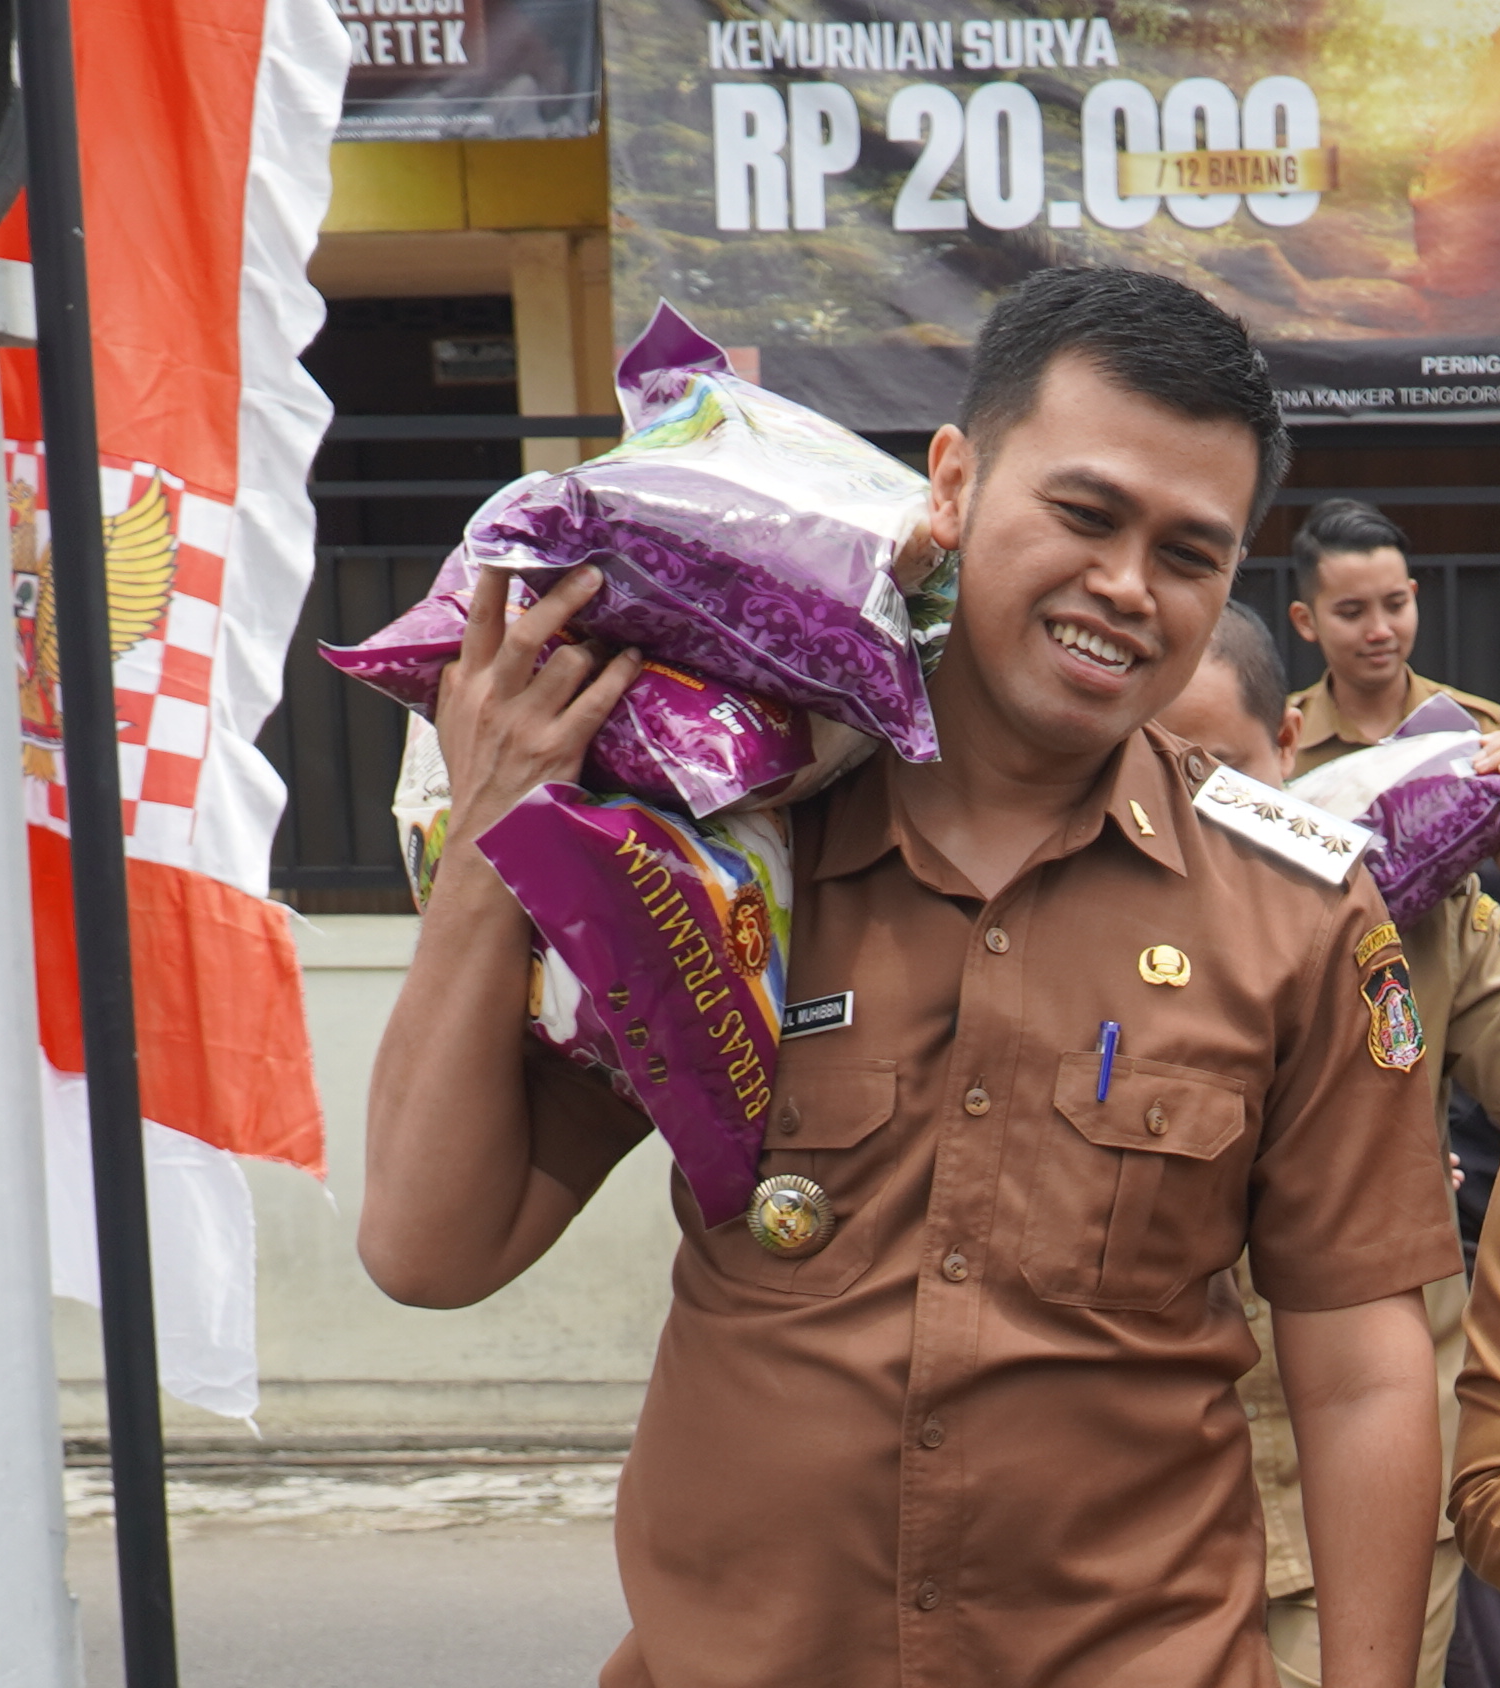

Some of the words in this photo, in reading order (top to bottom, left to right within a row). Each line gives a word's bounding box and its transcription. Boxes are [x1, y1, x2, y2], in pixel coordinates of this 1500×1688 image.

[347, 20, 469, 66] RETEK
[708, 20, 954, 70] KEMURNIAN
[961, 17, 1119, 69] SURYA
[712, 81, 861, 231] RP
[886, 75, 1322, 231] 20.000
[1177, 158, 1200, 187] 12
[1208, 156, 1299, 186] BATANG
[1313, 388, 1396, 407] KANKER
[615, 827, 731, 1014] PREMIUM
[708, 1010, 772, 1121] BERAS
